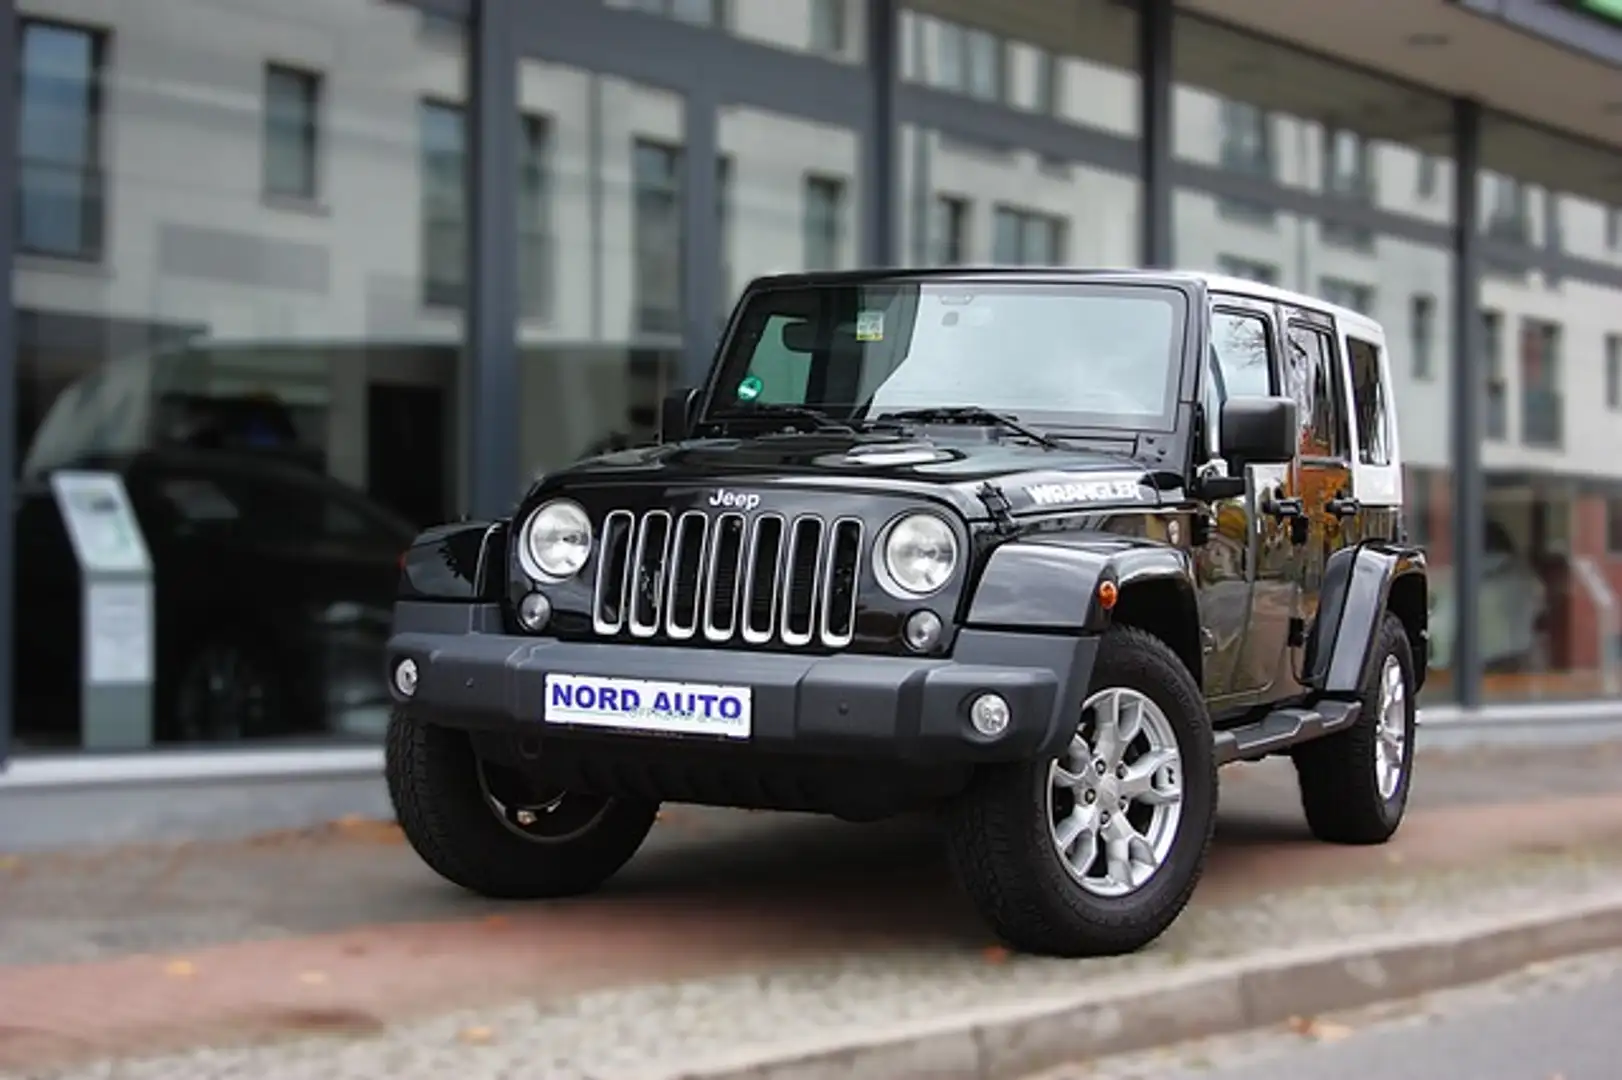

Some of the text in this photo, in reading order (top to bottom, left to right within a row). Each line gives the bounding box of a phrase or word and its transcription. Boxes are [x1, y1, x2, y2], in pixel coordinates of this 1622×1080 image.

[709, 488, 760, 510] Jeep
[1024, 481, 1144, 505] WRANGLER
[552, 683, 640, 712] NORD
[653, 692, 742, 719] AUTO
